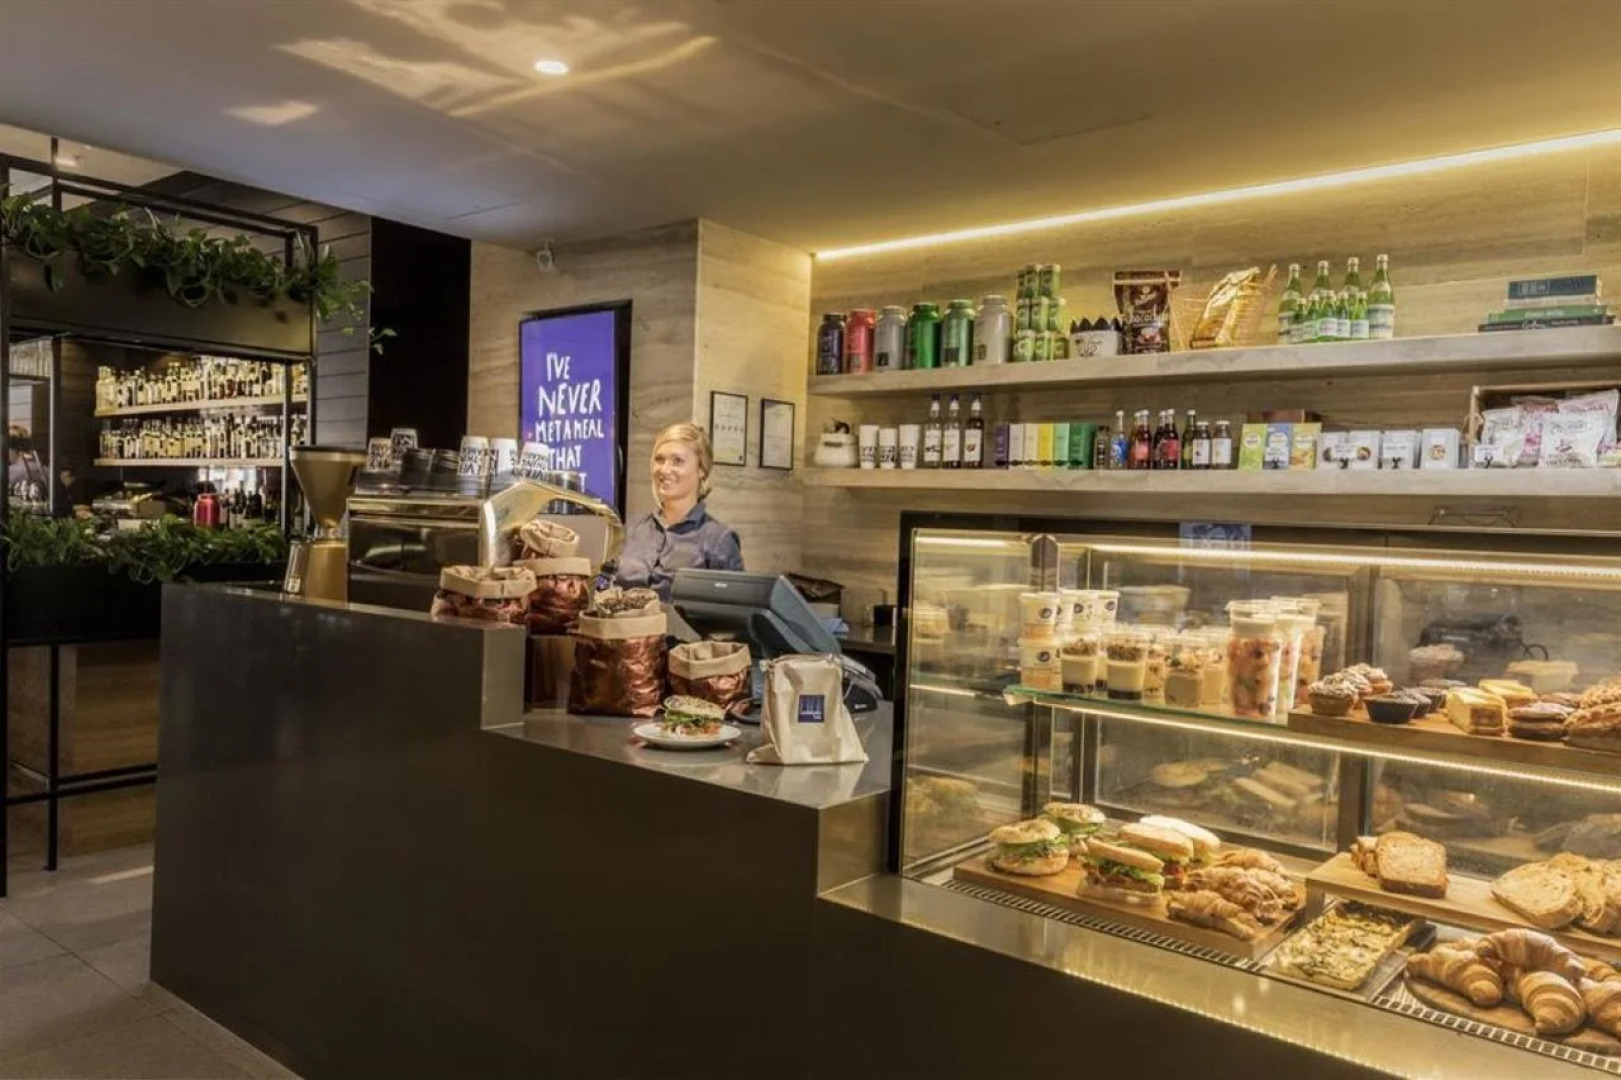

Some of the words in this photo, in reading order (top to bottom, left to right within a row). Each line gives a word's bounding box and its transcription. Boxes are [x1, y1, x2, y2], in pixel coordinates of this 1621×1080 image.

[538, 379, 602, 418] NEVER
[535, 420, 561, 443] MET
[563, 419, 572, 440] A
[574, 418, 604, 440] MEAL
[547, 445, 581, 471] THAT
